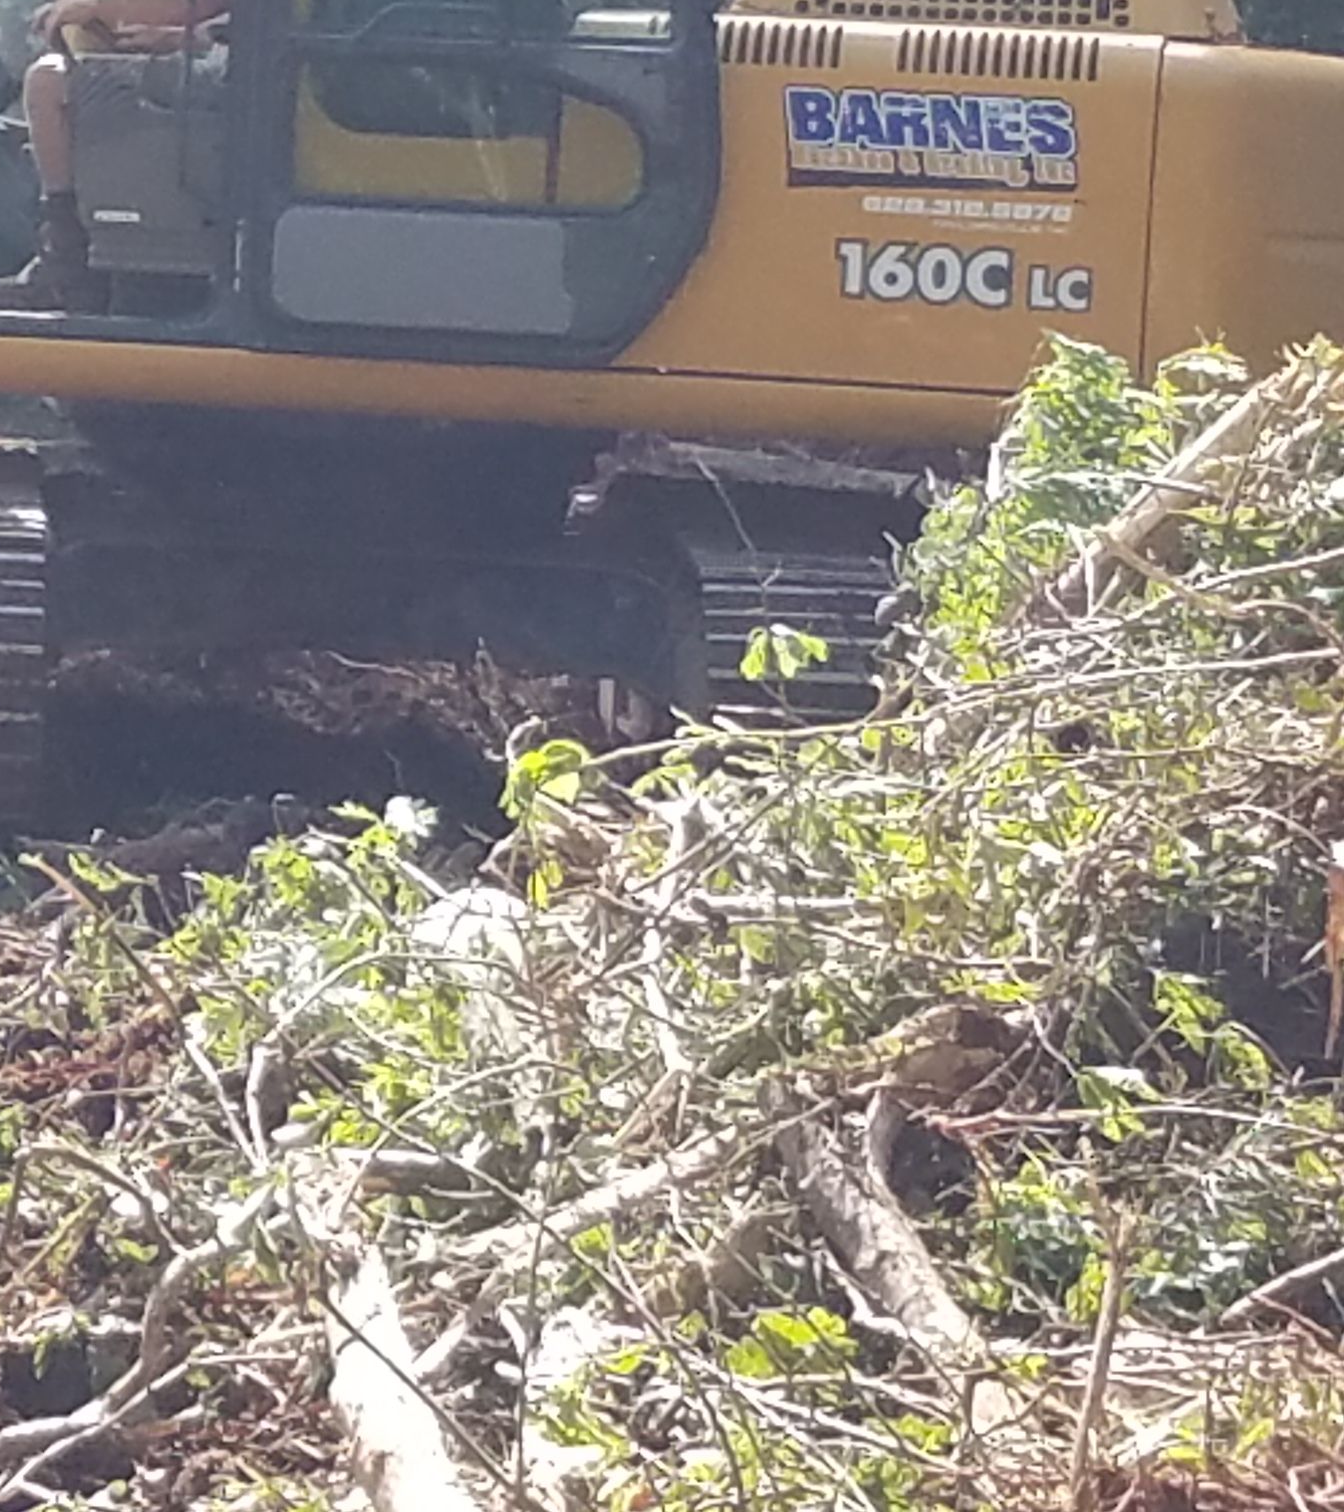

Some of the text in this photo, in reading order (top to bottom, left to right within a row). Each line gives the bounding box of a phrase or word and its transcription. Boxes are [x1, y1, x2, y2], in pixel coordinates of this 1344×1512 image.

[784, 86, 1078, 159] BARNES
[837, 239, 1092, 312] 160C LC
